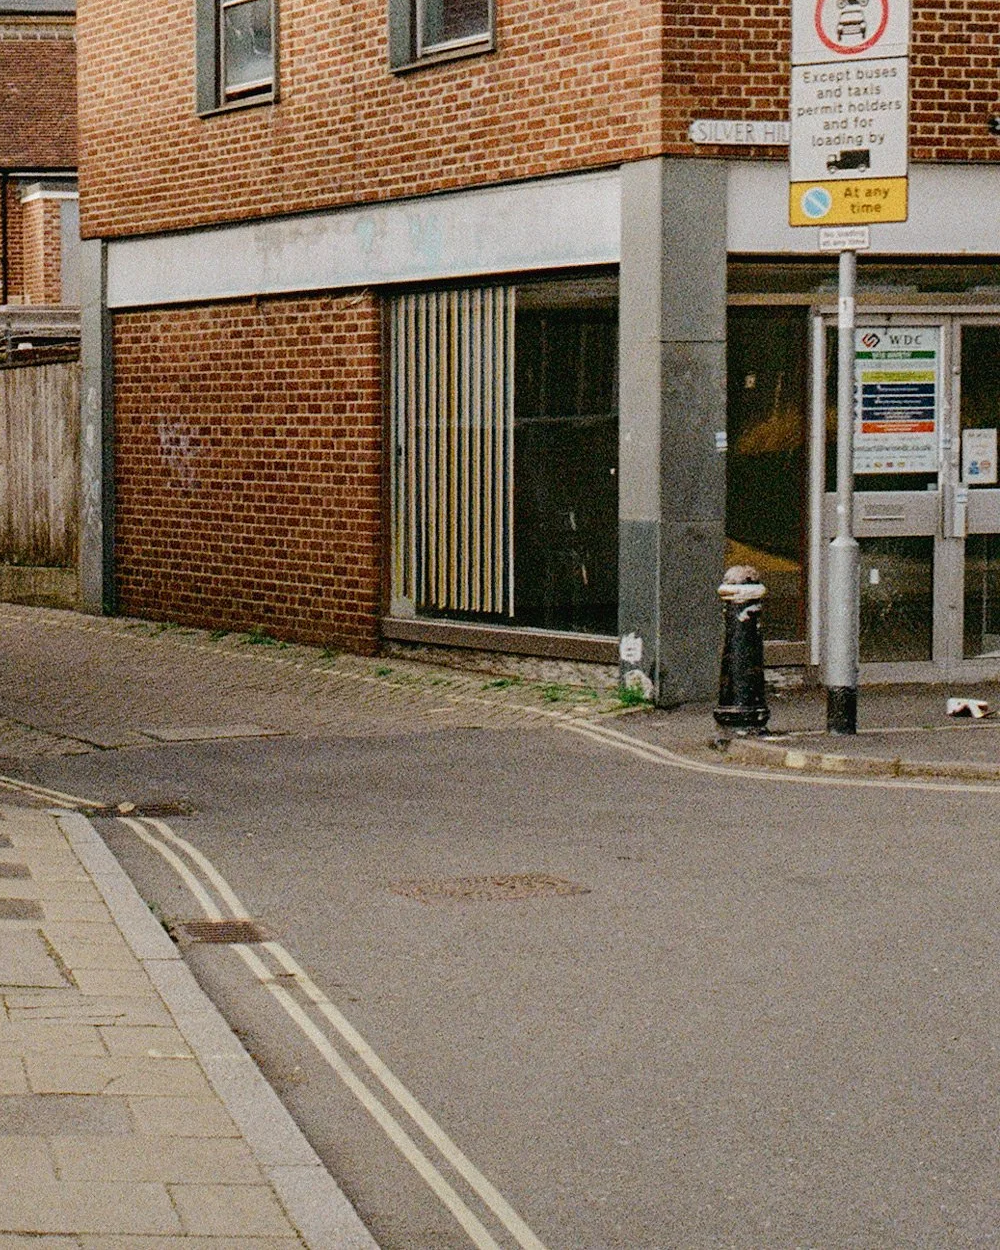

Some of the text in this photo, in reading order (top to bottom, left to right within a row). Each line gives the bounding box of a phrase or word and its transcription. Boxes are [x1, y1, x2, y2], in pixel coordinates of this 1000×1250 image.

[803, 68, 898, 83] Except buses
[816, 84, 881, 99] and taxis
[797, 100, 902, 117] permit holders
[823, 116, 874, 130] and for
[697, 123, 790, 143] SILVER HIL
[812, 132, 885, 147] loading by
[843, 187, 890, 199] At any
[850, 202, 882, 214] time
[889, 334, 922, 345] WDC
